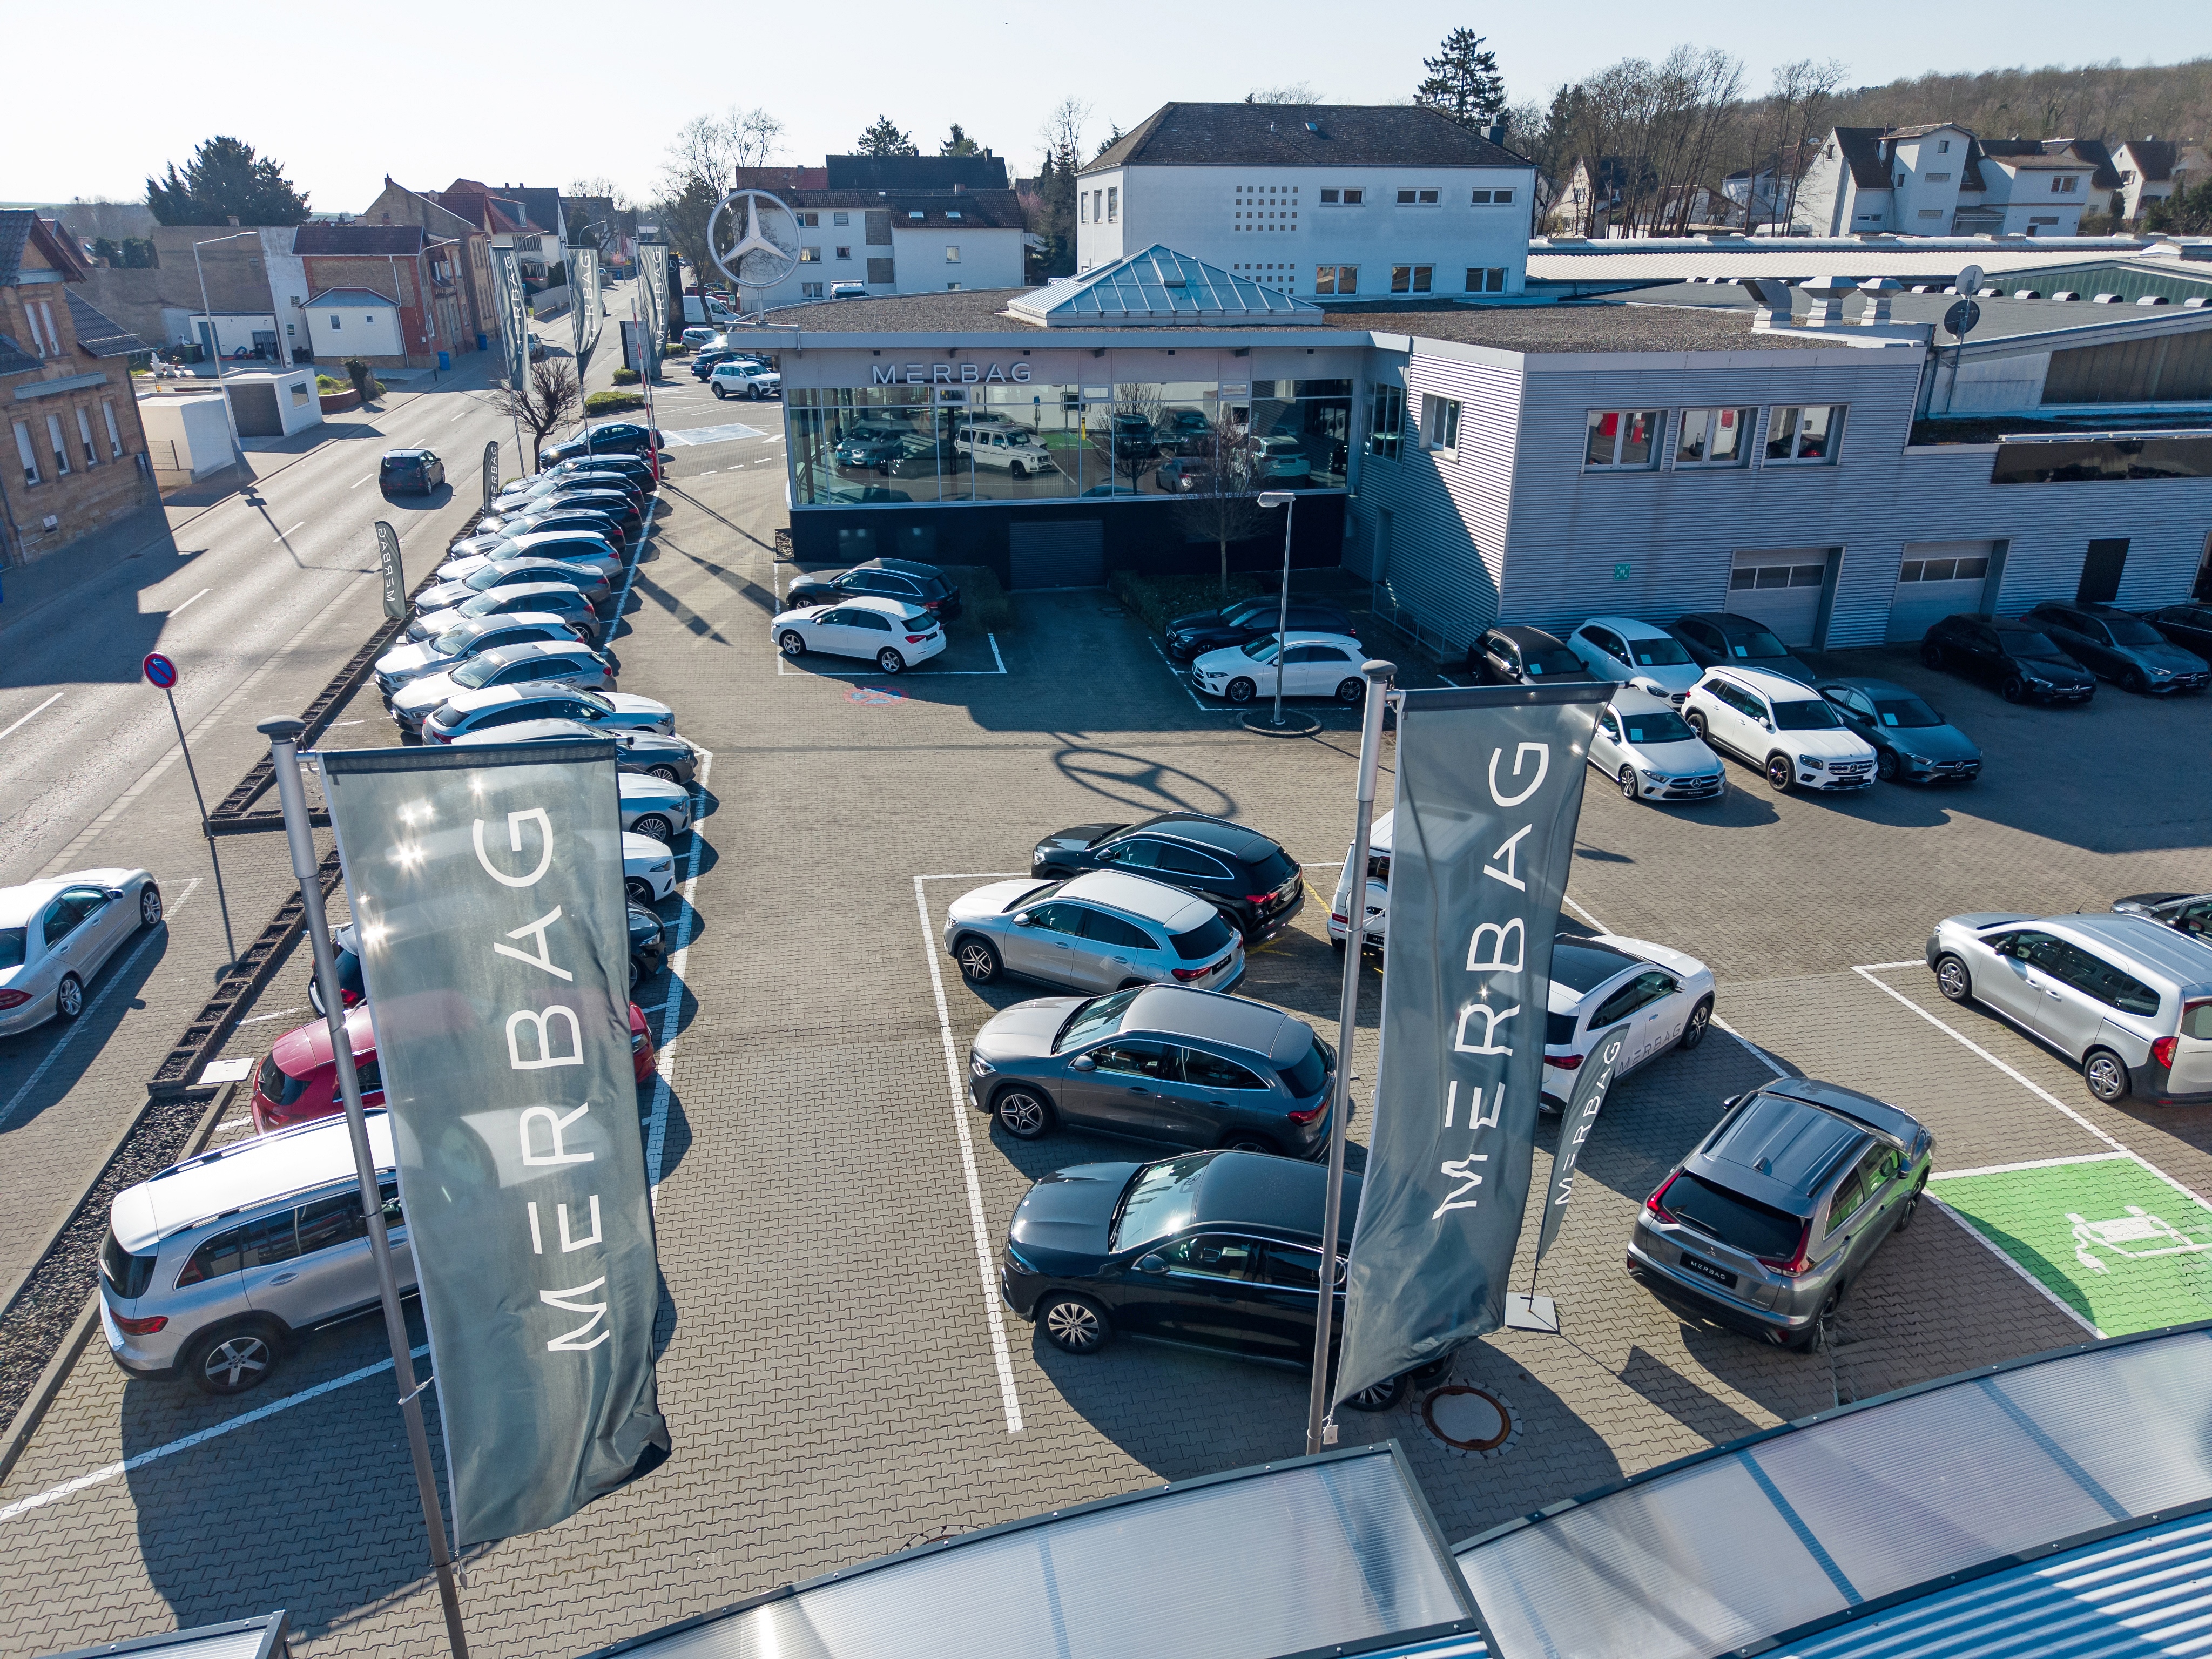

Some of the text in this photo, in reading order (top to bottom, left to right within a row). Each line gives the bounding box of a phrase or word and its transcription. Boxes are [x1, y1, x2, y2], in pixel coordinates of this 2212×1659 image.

[504, 256, 522, 354] MERBAG
[653, 251, 665, 344] MERBAG
[872, 363, 1031, 384] MERBAG
[490, 446, 498, 507] MERBAG
[1282, 885, 1292, 895] MERBAG
[1216, 957, 1229, 969] MERBAG
[1432, 741, 1550, 1220] MERBAG
[1620, 1023, 1682, 1072] MERBAG
[473, 807, 610, 1352] MERBAG
[1555, 1041, 1621, 1206] MERBAG
[1690, 1260, 1726, 1280] MERBAG
